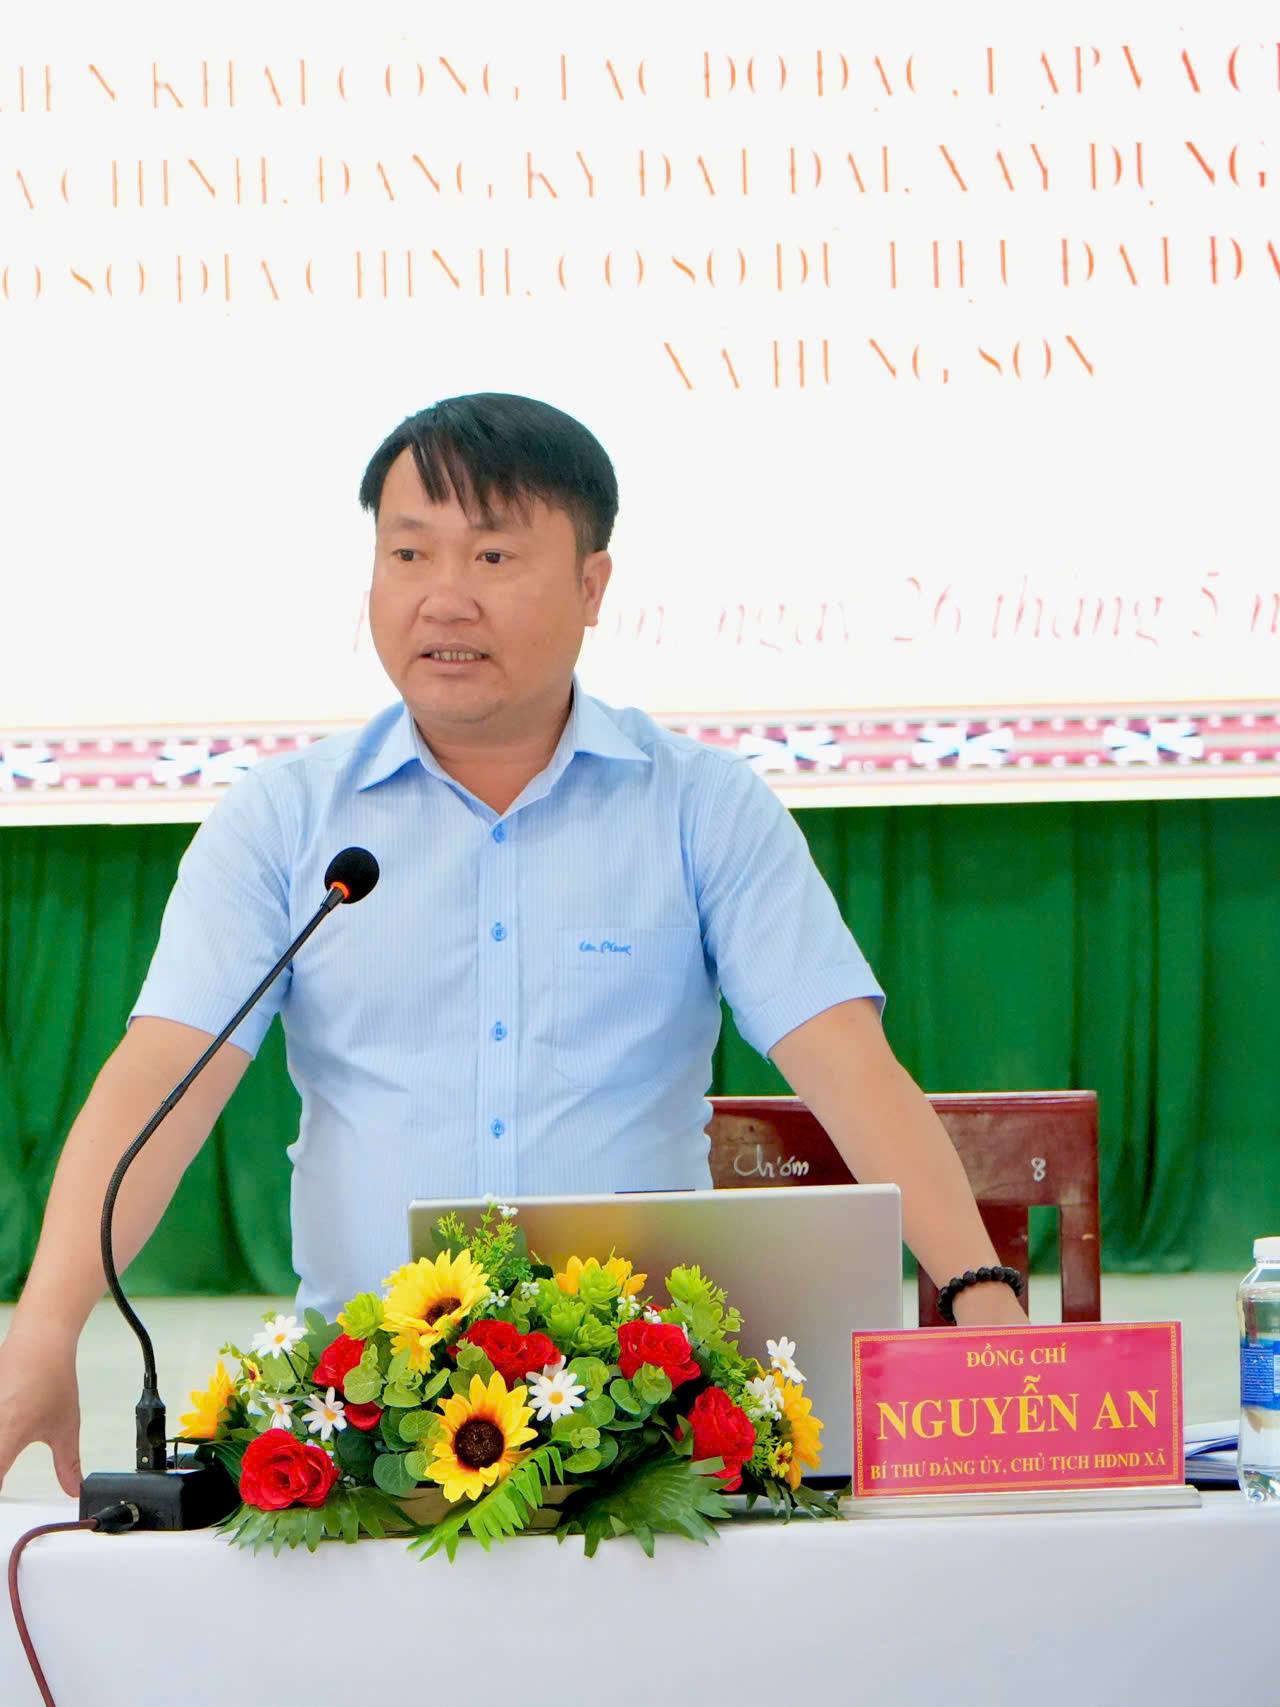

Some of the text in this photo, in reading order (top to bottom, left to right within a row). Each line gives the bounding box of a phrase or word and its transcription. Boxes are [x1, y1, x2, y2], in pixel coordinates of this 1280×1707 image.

[1030, 1156, 1047, 1182] 8
[966, 1342, 1067, 1368] ĐỒNG CHÍ
[876, 1374, 1160, 1441] NGUYỄN AN
[870, 1447, 1166, 1480] BÍ THƯ ĐẢNG ỦY, CHỦ TỊCH HĐND XÃ
